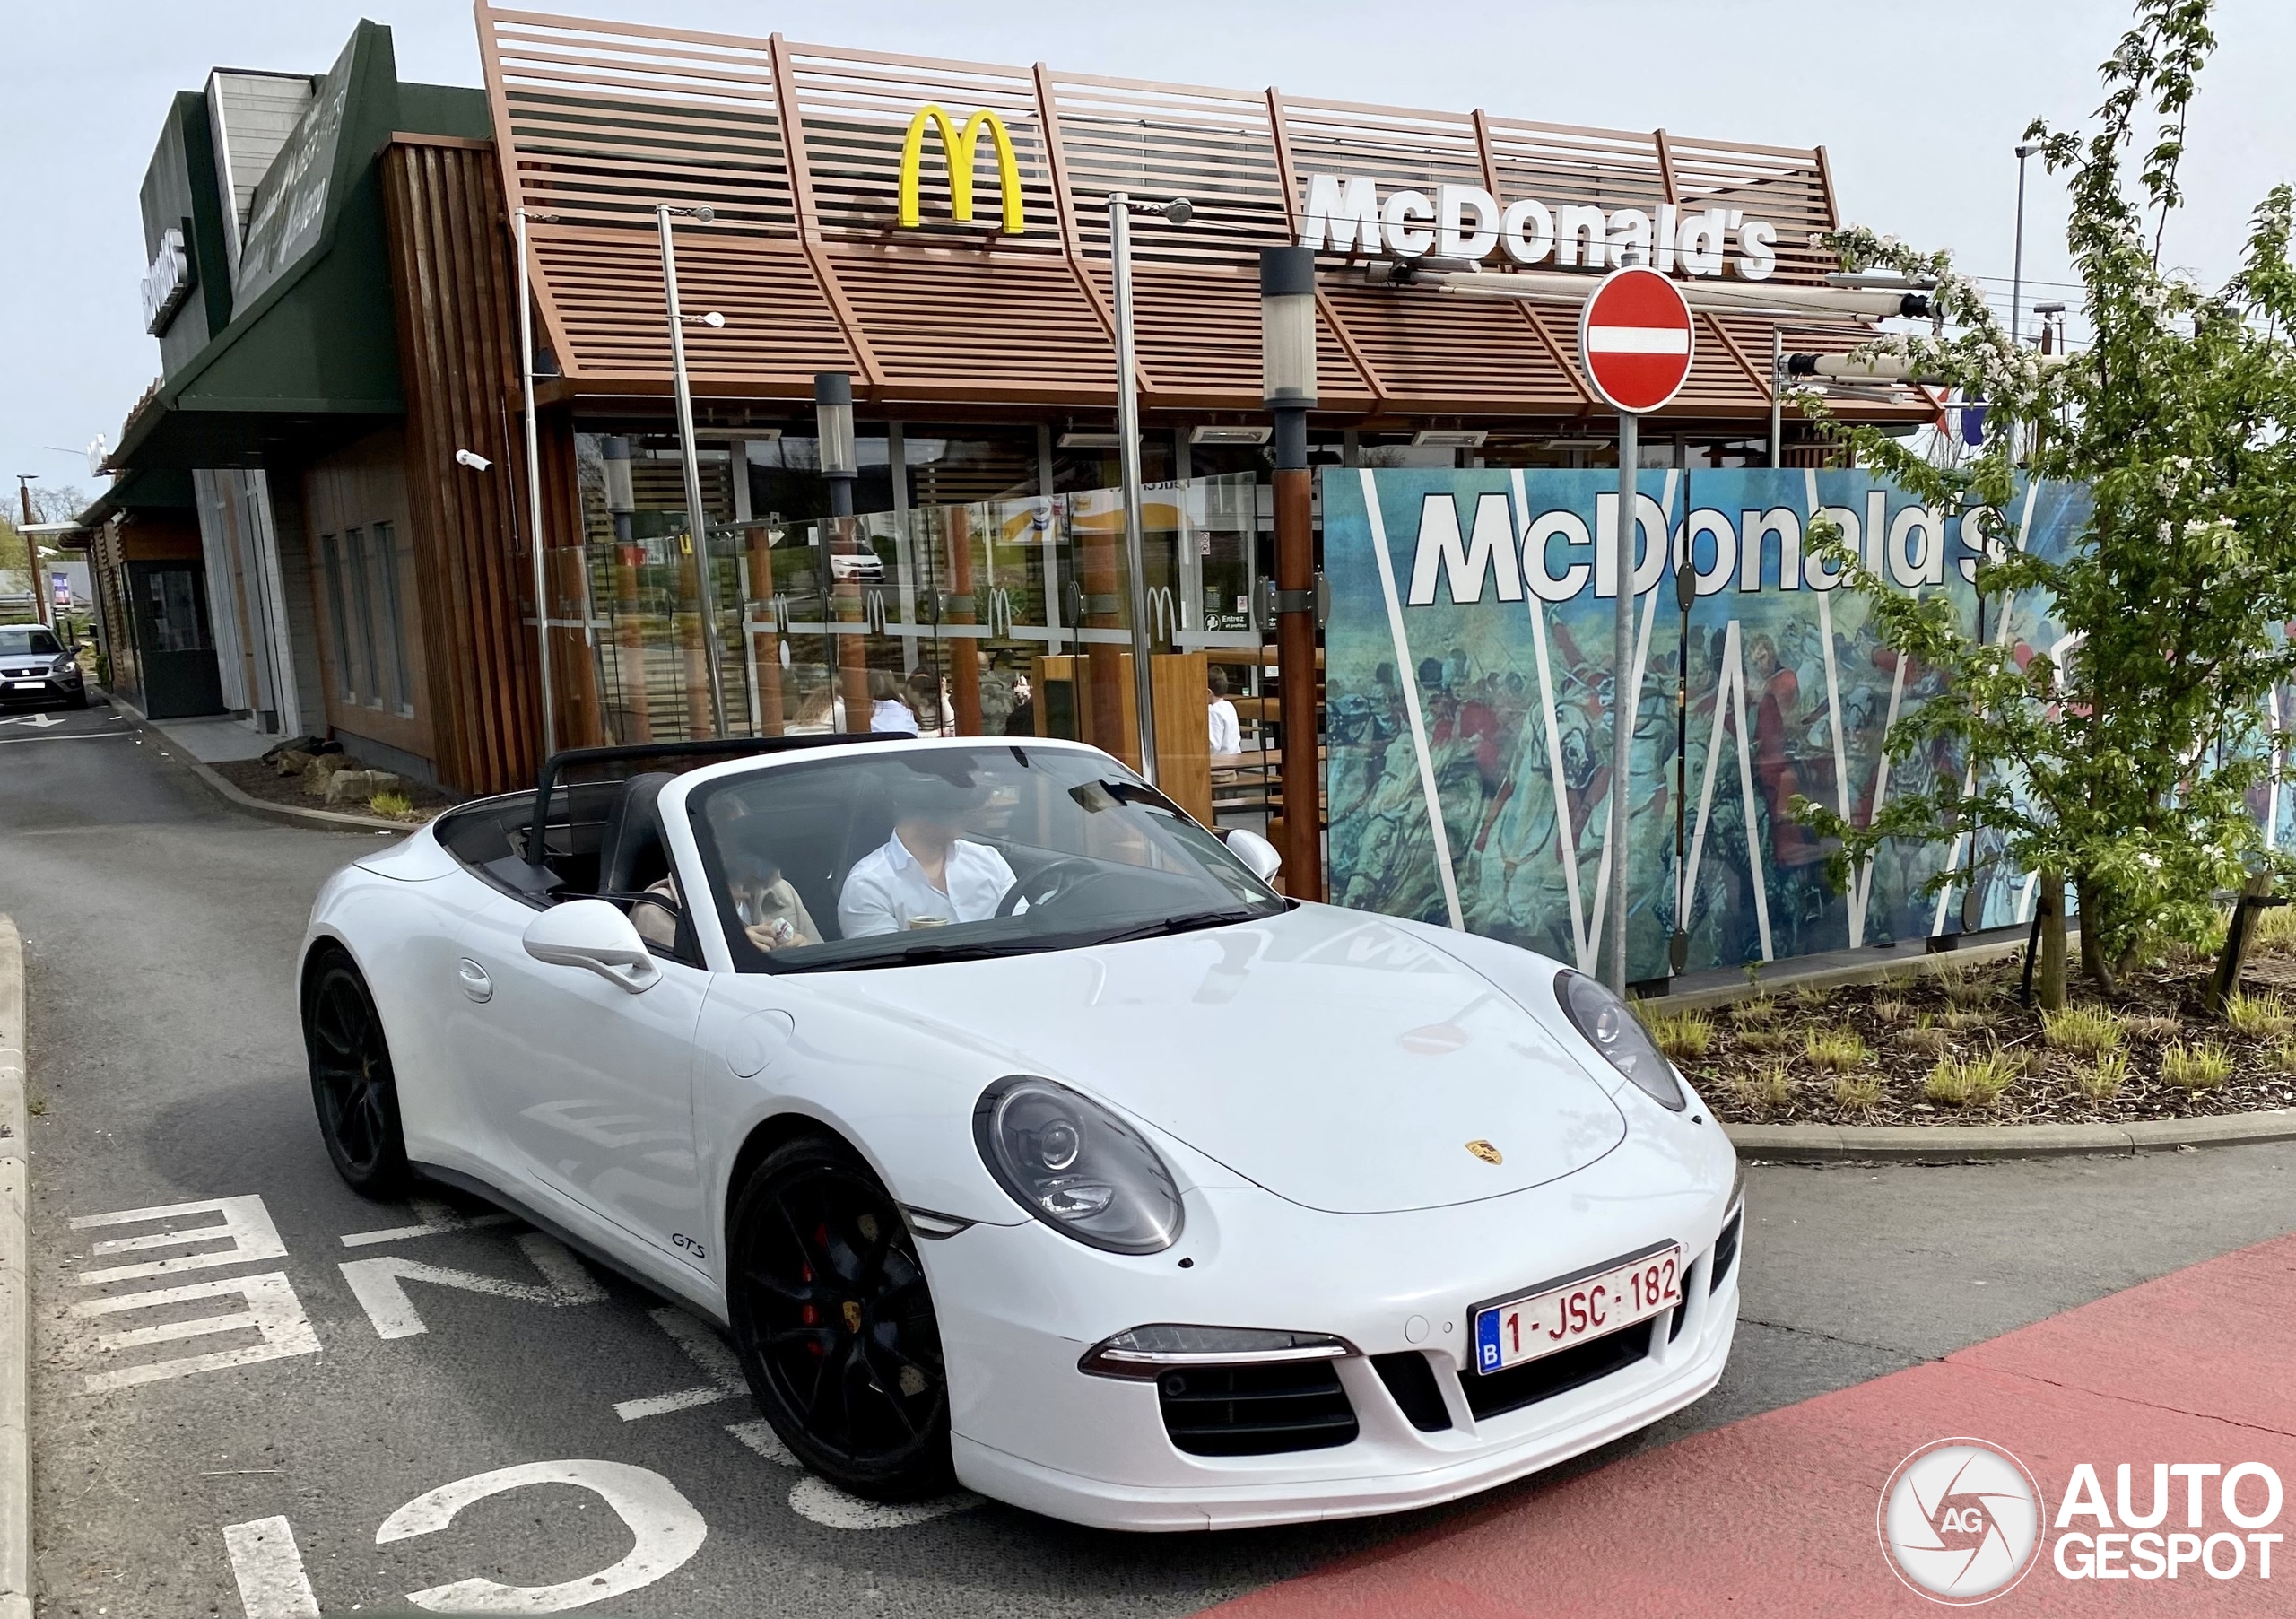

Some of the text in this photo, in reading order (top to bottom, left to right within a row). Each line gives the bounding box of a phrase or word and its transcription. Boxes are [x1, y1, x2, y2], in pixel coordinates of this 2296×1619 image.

[1299, 173, 1778, 281] McDonald's
[672, 1232, 706, 1259] GTS
[1484, 1344, 1498, 1365] B
